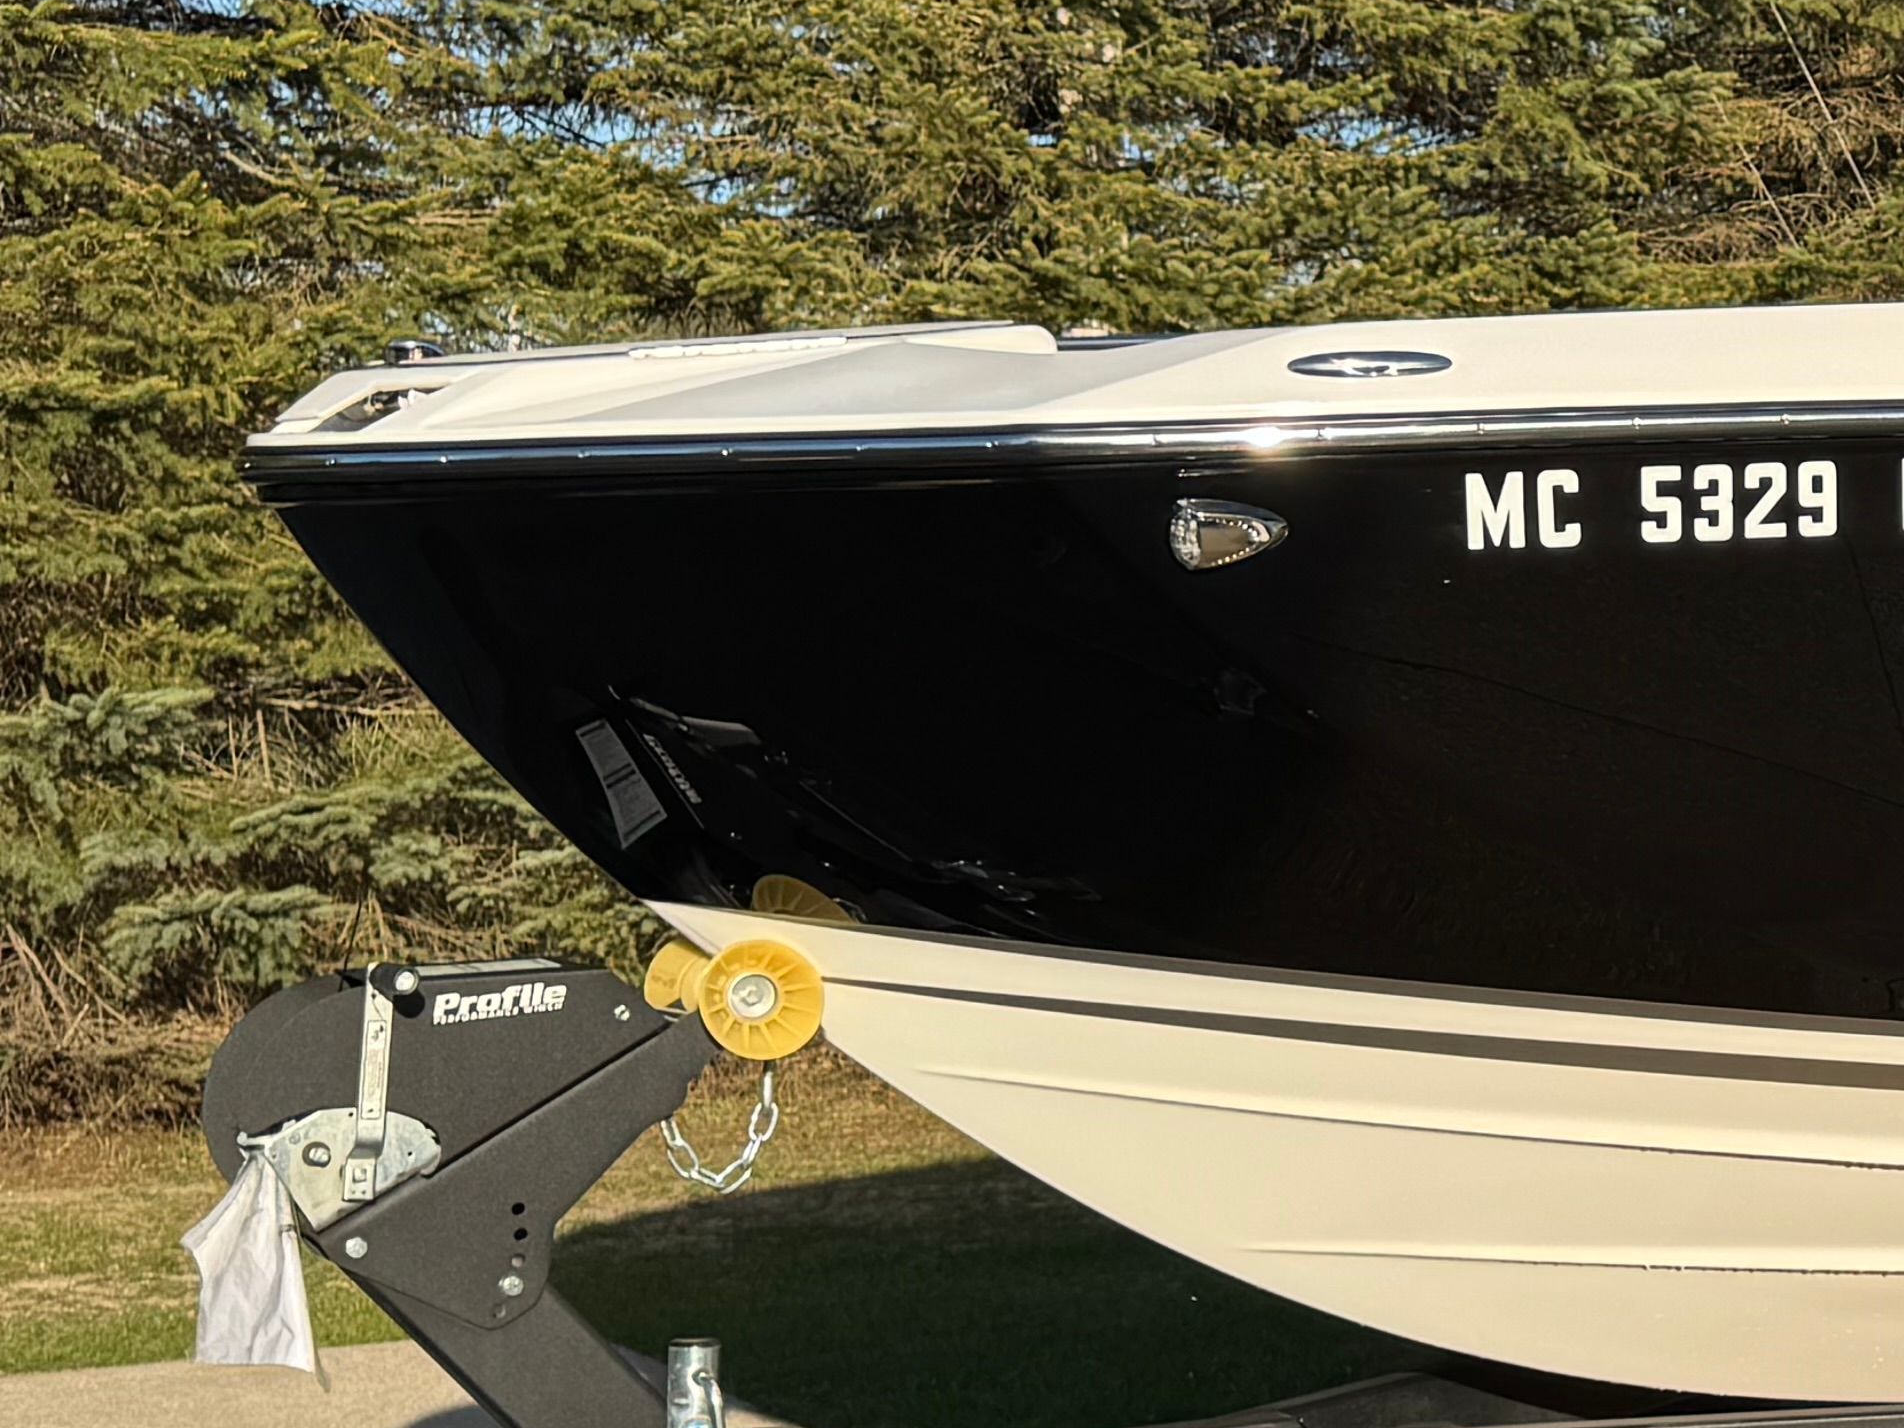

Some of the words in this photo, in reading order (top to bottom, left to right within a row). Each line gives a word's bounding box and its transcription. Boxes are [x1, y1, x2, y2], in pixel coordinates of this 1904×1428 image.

[1464, 468, 1582, 551] MC
[1640, 460, 1838, 544] 5329
[433, 982, 567, 1018] Profile
